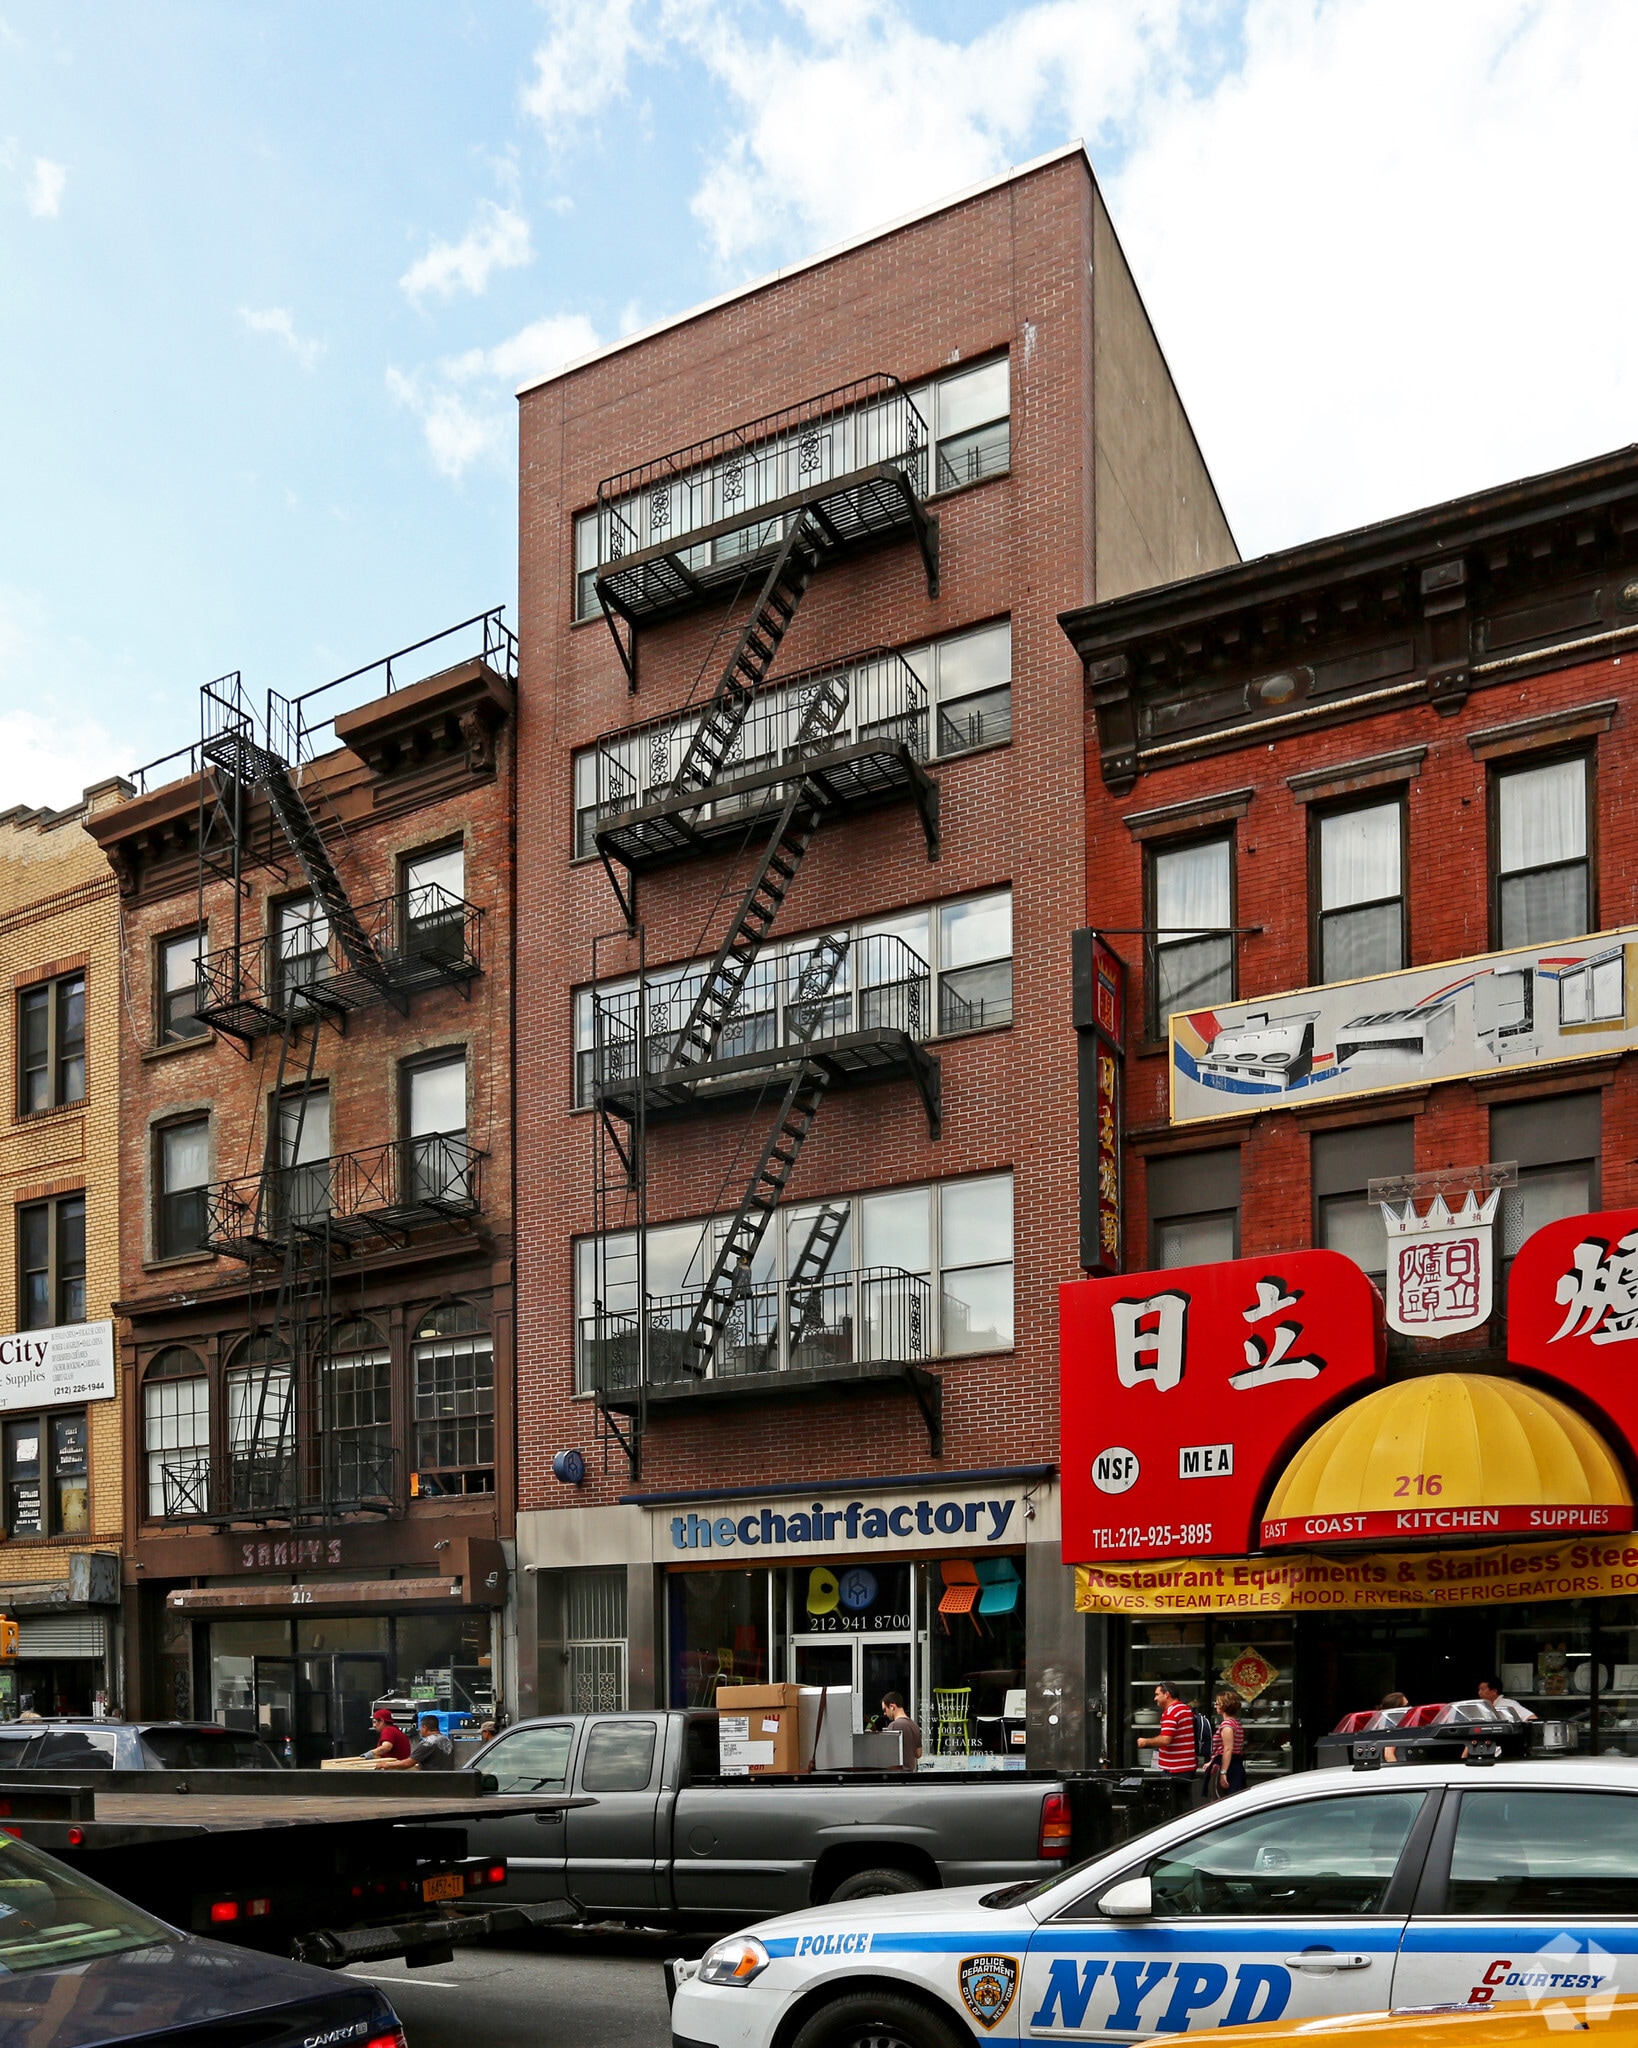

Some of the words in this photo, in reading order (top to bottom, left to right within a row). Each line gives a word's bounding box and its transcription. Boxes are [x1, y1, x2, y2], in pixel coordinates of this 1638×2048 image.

[1111, 1279, 1328, 1393] 日立
[0, 1338, 48, 1367] City
[5, 1370, 46, 1388] Supplies
[54, 1386, 71, 1396] (212)
[73, 1382, 105, 1393] 226-1944
[1097, 1457, 1133, 1480] NSF
[1394, 1474, 1443, 1497] 216
[1265, 1522, 1288, 1539] EAST
[1305, 1516, 1367, 1534] COAST
[1397, 1510, 1500, 1528] KITCHEN
[1529, 1509, 1609, 1526] SUPPLIES
[1088, 1567, 1225, 1589] Restaurant
[1233, 1560, 1387, 1590] Equipments
[1397, 1561, 1416, 1582] &
[1426, 1552, 1561, 1581] Stainless
[1083, 1594, 1149, 1608] STOVES.
[1154, 1594, 1212, 1608] STEAM
[1216, 1592, 1285, 1607] TABLES.
[1435, 1576, 1604, 1602] REFRIGERATORS.
[810, 1616, 836, 1631] 212
[841, 1615, 867, 1631] 941
[874, 1614, 911, 1630] 8700
[937, 1727, 963, 1735] 10012
[944, 1739, 983, 1747] CHAIRS
[798, 1933, 869, 1957] POLICE
[962, 1965, 1015, 1980] DEPARTMENT
[973, 1957, 1005, 1967] POLICE
[992, 2004, 1006, 2020] NEW
[1003, 1982, 1015, 2003] YORK
[1030, 1959, 1292, 2033] NYPD
[972, 2007, 982, 2017] OF
[304, 2025, 355, 2048] CAMRY
